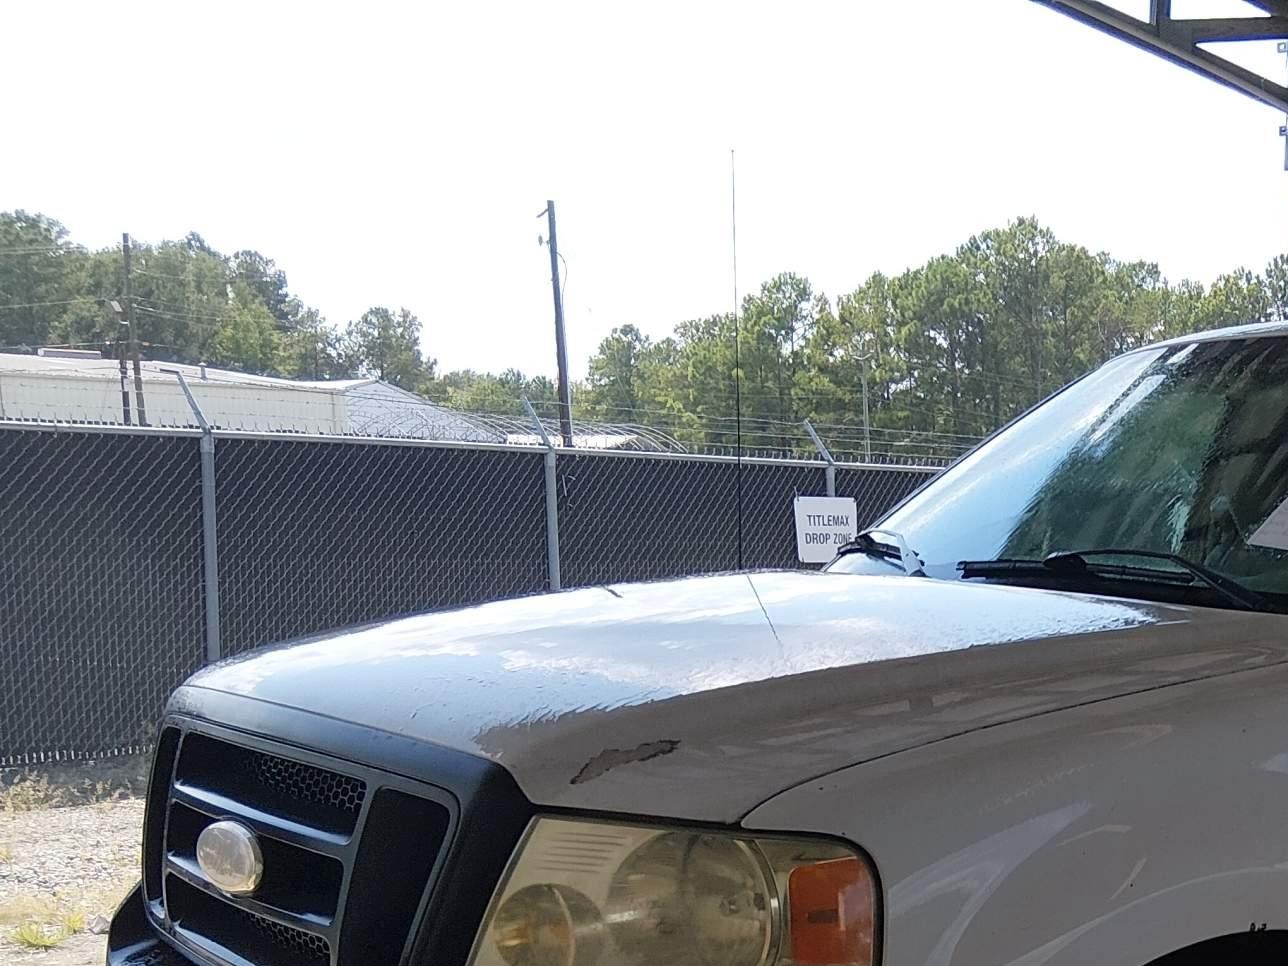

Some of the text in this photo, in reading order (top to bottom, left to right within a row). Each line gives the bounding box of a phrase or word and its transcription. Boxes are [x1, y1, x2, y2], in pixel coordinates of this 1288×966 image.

[806, 514, 850, 527] TITLEMAX
[805, 532, 852, 545] DROP ZONE
